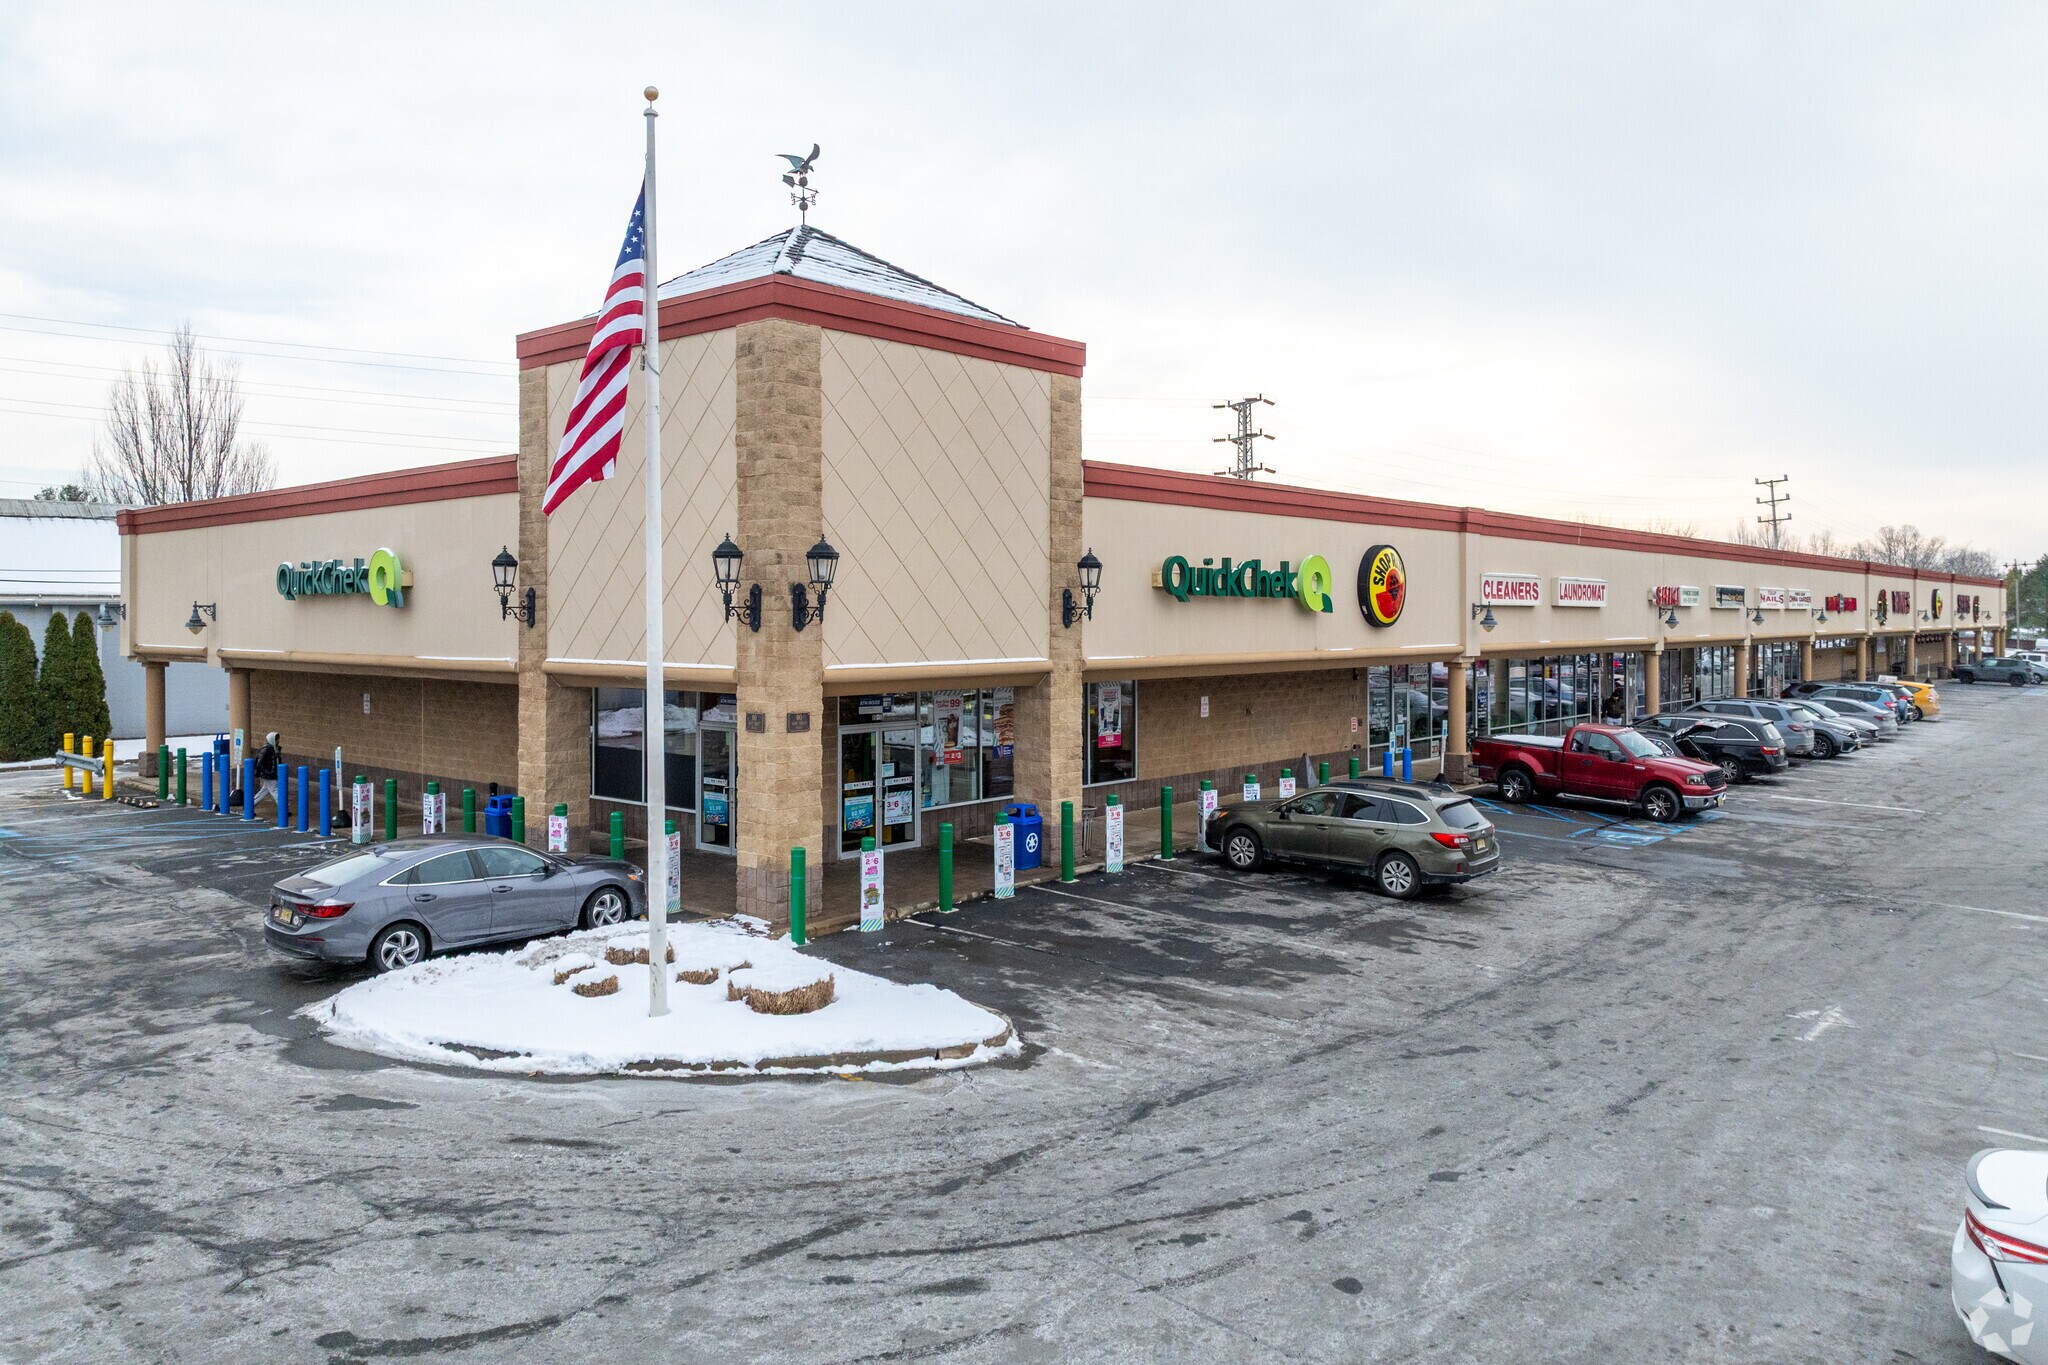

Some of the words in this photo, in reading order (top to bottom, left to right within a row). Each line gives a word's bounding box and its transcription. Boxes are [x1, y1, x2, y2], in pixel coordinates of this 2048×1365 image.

[277, 558, 365, 601] QuickChek
[1162, 556, 1297, 602] QuickChek
[1483, 579, 1539, 601] CLEANERS
[1559, 582, 1606, 602] LAUNDROMAT
[1760, 594, 1784, 604] NAILS
